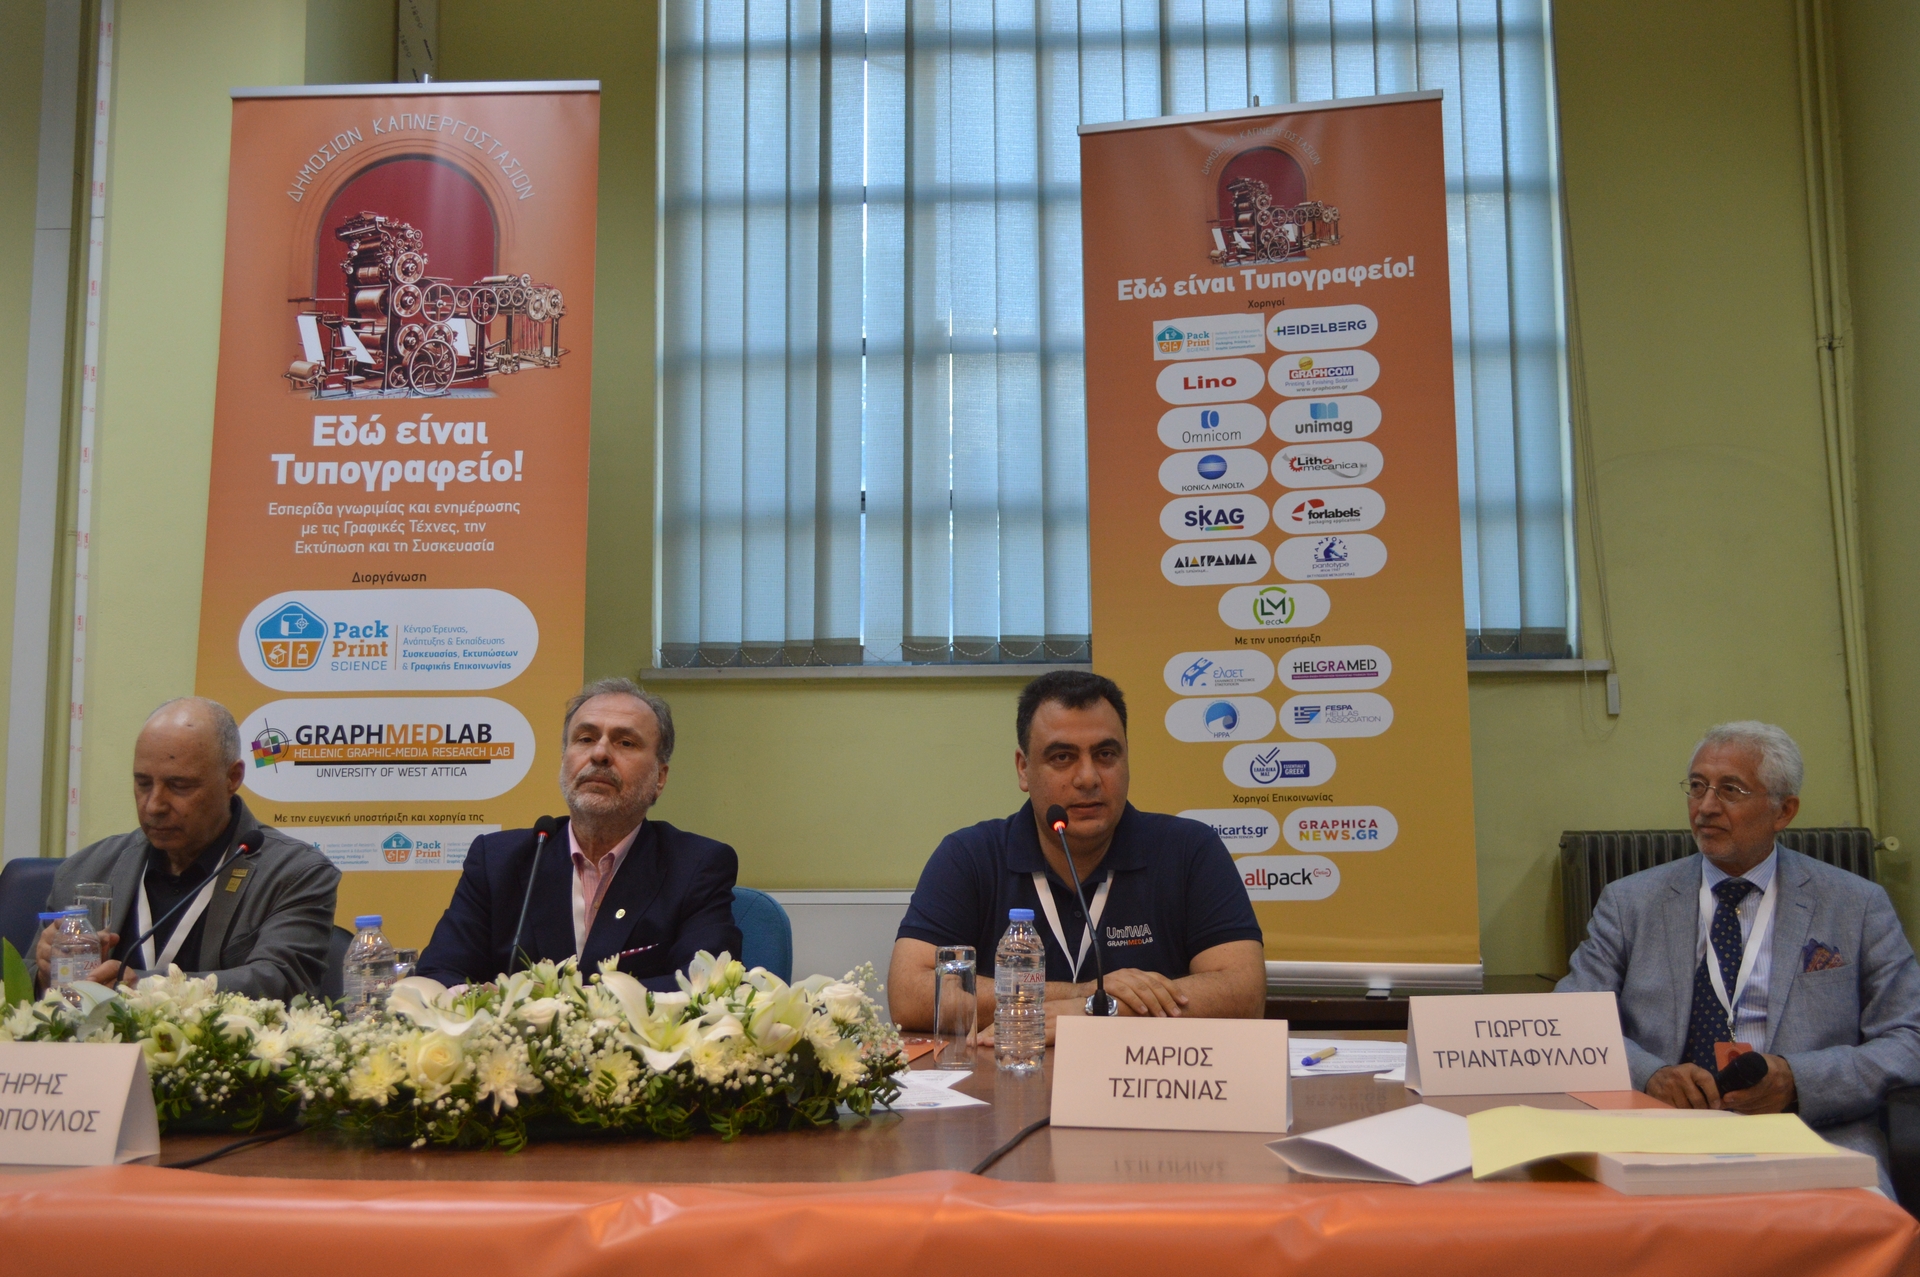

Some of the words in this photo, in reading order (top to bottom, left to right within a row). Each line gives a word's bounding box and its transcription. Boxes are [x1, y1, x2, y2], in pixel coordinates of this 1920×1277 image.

[287, 127, 363, 202] ΔΗΜΟΣΙΟΝ
[373, 113, 535, 200] ΚΑΠΝΕΡΓΟΣΤΑΣΙΟΝ
[1118, 276, 1167, 300] Εδώ
[1173, 272, 1235, 296] είναι
[1240, 256, 1414, 291] Τυπογραφείο!
[1248, 298, 1285, 309] Χορηγοί
[1278, 320, 1367, 336] HEIDELBERG
[1187, 331, 1209, 339] Pack
[1187, 339, 1210, 347] Print
[1291, 367, 1352, 378] GRAPHCOM
[1183, 376, 1236, 389] Lino
[1297, 384, 1348, 392] www.graphcom.gr
[313, 414, 386, 446] Εδώ
[396, 413, 488, 445] είναι
[1295, 420, 1353, 434] unimag
[1182, 430, 1241, 443] Omnicom
[271, 451, 524, 492] Τυπογραφείο!
[1303, 462, 1358, 471] mecanica
[1182, 483, 1210, 491] KONICA
[1212, 482, 1244, 490] MINOLTA
[269, 502, 333, 517] Εσπερίδα
[337, 501, 404, 517] γνωριμίας
[409, 502, 430, 513] και
[434, 501, 520, 516] ενημέρωσης
[1308, 508, 1360, 519] forlabels
[302, 524, 318, 537] με
[322, 524, 339, 535] τις
[344, 521, 405, 535] Γραφικές
[410, 520, 460, 534] Τέχνες,
[464, 521, 486, 532] την
[295, 541, 364, 554] Εκτύπωση
[369, 540, 389, 552] και
[394, 541, 408, 552] τη
[412, 538, 494, 552] Συσκευασία
[1174, 554, 1257, 568] ΔΙΑΓΡΑΜΜΑ
[352, 571, 427, 584] Διοργάνωση
[1261, 597, 1286, 616] LM
[333, 620, 389, 638] Pack
[403, 625, 431, 634] Κέντρο
[1235, 636, 1247, 645] Με
[1250, 637, 1265, 645] την
[1268, 634, 1321, 645] υποστήριξη
[332, 640, 388, 657] Print
[463, 649, 518, 657] Εκτυπώσεων
[331, 661, 387, 671] SCIENCE
[411, 662, 451, 672] Γραφικής
[1213, 667, 1244, 678] ελσετ
[1293, 659, 1376, 673] HELGRAMED
[296, 724, 492, 745] GRAPHMEDLAB
[294, 748, 343, 758] HELLENIC
[347, 748, 428, 758] GRAPHIC-MEDIA
[433, 747, 486, 757] RESEARCH
[490, 747, 510, 756] LAB
[317, 768, 377, 778] UNIVERSITY
[381, 768, 394, 777] OF
[398, 767, 427, 776] WEST
[431, 767, 467, 776] ATTICA
[1233, 794, 1269, 804] Χορηγοί
[1272, 793, 1333, 803] Επικοινωνίας
[274, 814, 287, 823] Με
[291, 814, 306, 823] την
[309, 813, 350, 824] ευγενική
[354, 813, 408, 824] υποστήριξη
[411, 814, 426, 822] και
[429, 813, 466, 823] χορηγία
[469, 813, 484, 822] της
[1299, 819, 1378, 830] GRAPHICA
[1299, 830, 1378, 841] NEWS.GR
[416, 841, 441, 850] Pack
[415, 849, 441, 857] Print
[1245, 868, 1312, 889] allpack
[1106, 924, 1151, 939] UniWA
[1107, 937, 1153, 946] GRAPHMEDLAB
[1474, 1019, 1561, 1040] ΓΙΩΡΓΟΣ
[1125, 1046, 1213, 1068] ΜΑΡΙΟΣ
[1432, 1046, 1610, 1070] ΤΡΙΑΝΤΑΦΥΛΛΟΥ
[1109, 1077, 1228, 1101] ΤΣΙΓΩΝΙΑΣ
